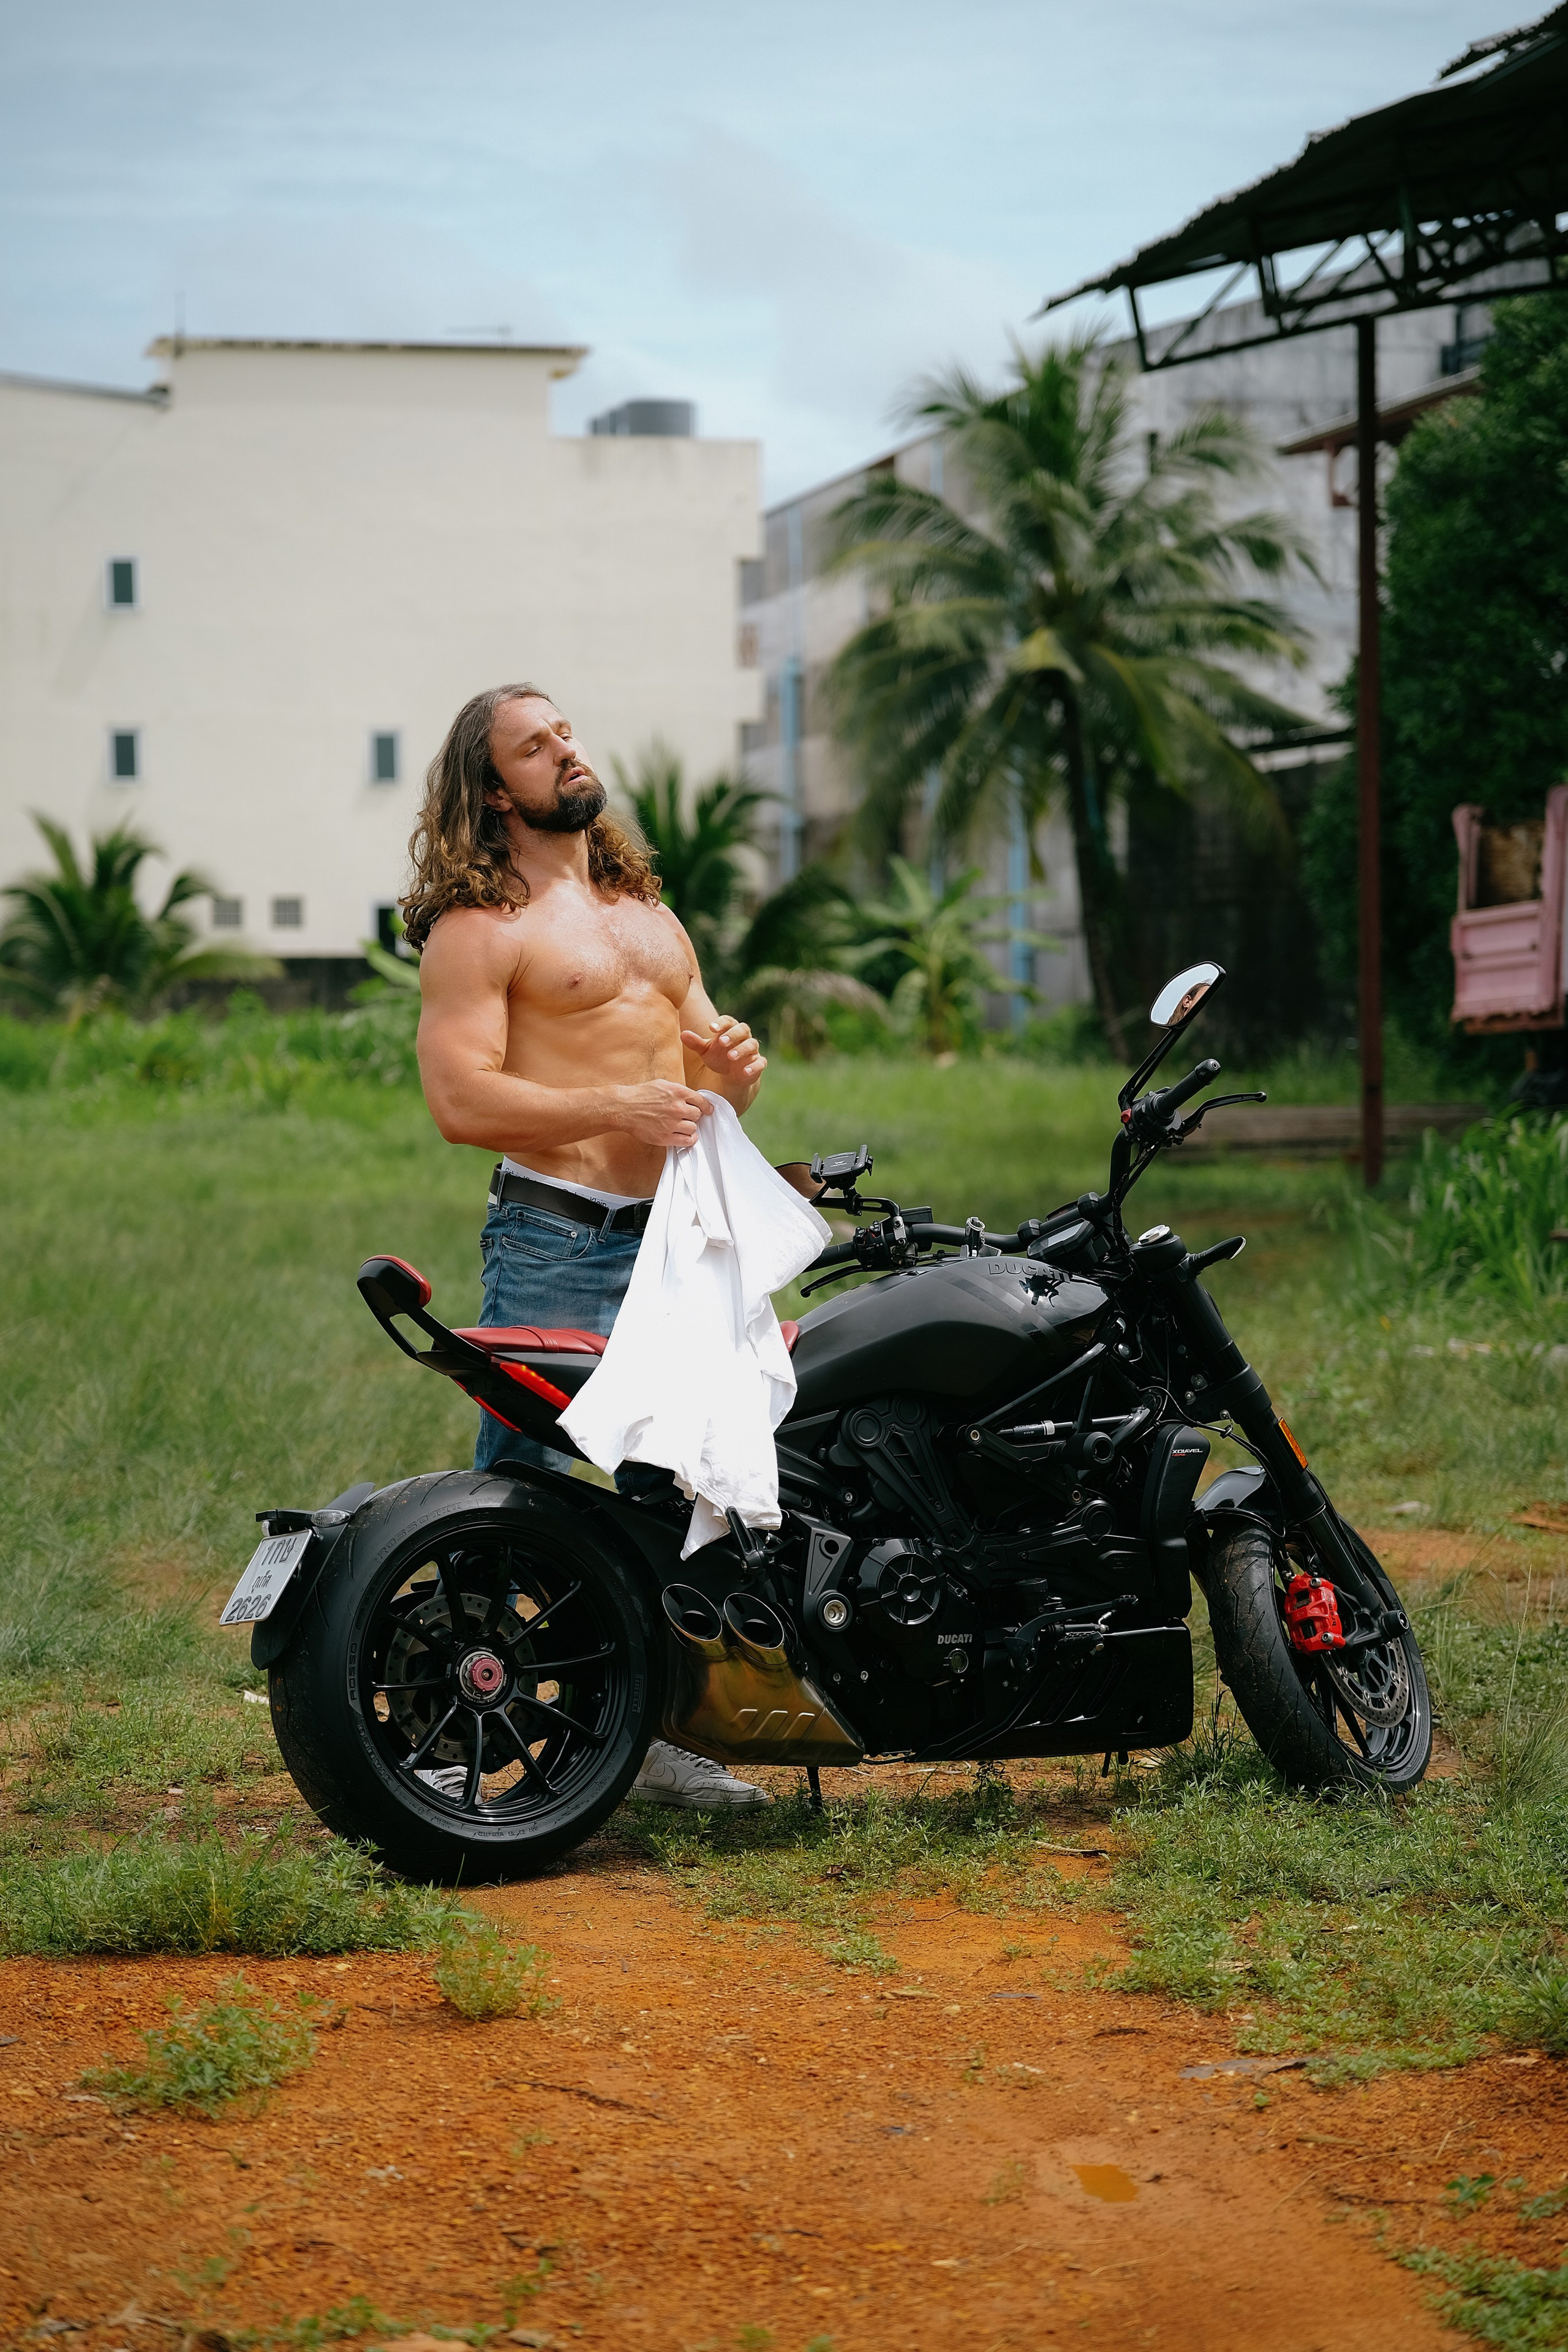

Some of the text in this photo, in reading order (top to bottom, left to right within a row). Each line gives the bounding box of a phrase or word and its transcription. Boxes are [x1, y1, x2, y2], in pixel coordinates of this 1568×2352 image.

[988, 1262, 1071, 1283] DUCATI
[377, 1515, 429, 1561] ROSSO
[225, 1593, 271, 1622] 2626
[937, 1634, 973, 1645] DUCATI
[349, 1642, 358, 1701] ROSSO
[631, 1673, 644, 1714] PIRELLI
